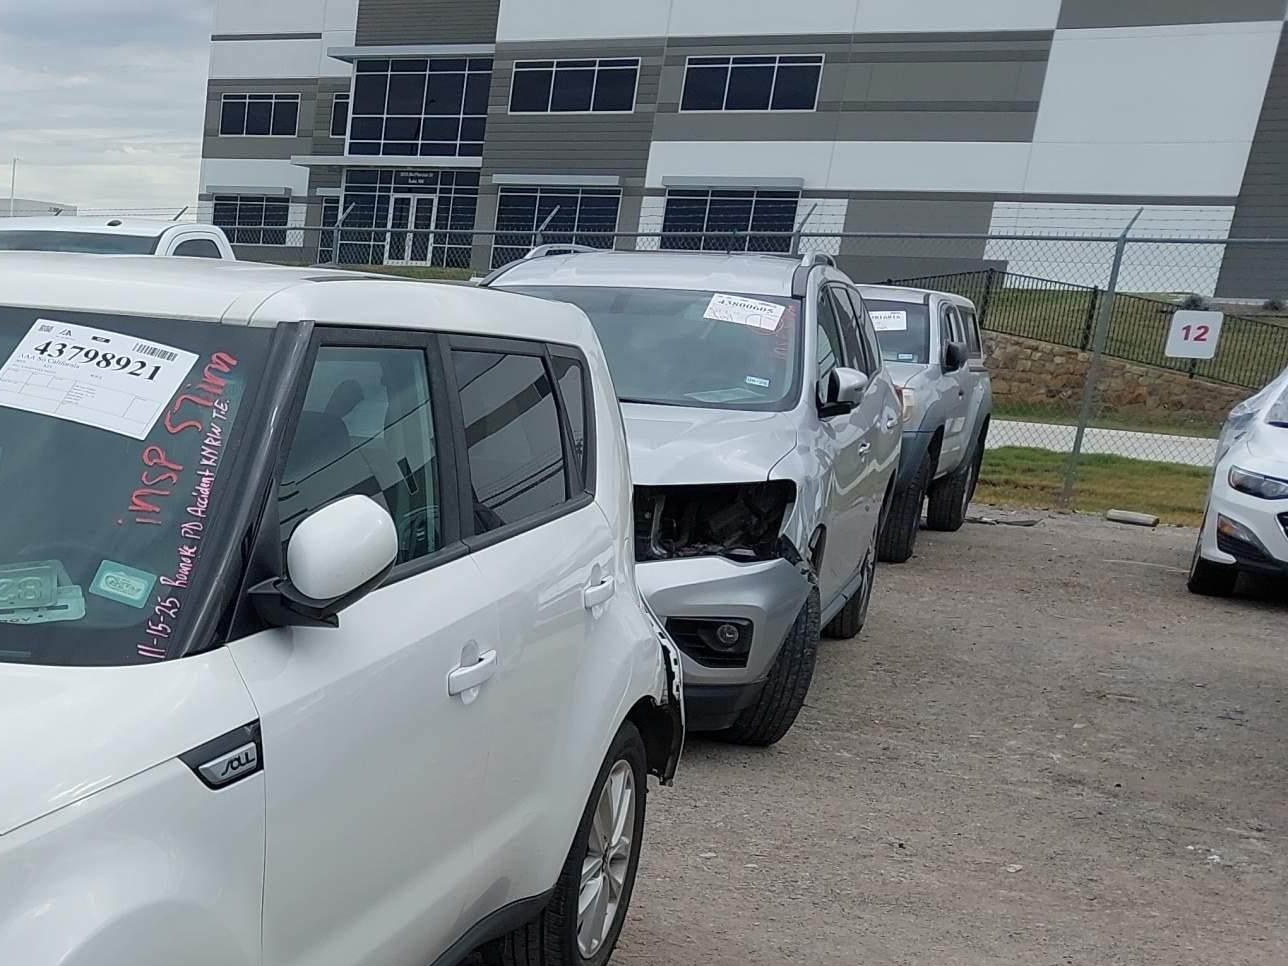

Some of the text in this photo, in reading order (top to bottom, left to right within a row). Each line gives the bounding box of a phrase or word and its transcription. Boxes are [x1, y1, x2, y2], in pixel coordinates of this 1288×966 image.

[1182, 325, 1209, 342] 12
[33, 340, 162, 381] 43798921
[47, 358, 81, 369] California
[137, 596, 181, 659] 11-15-25
[186, 469, 215, 518] Accident
